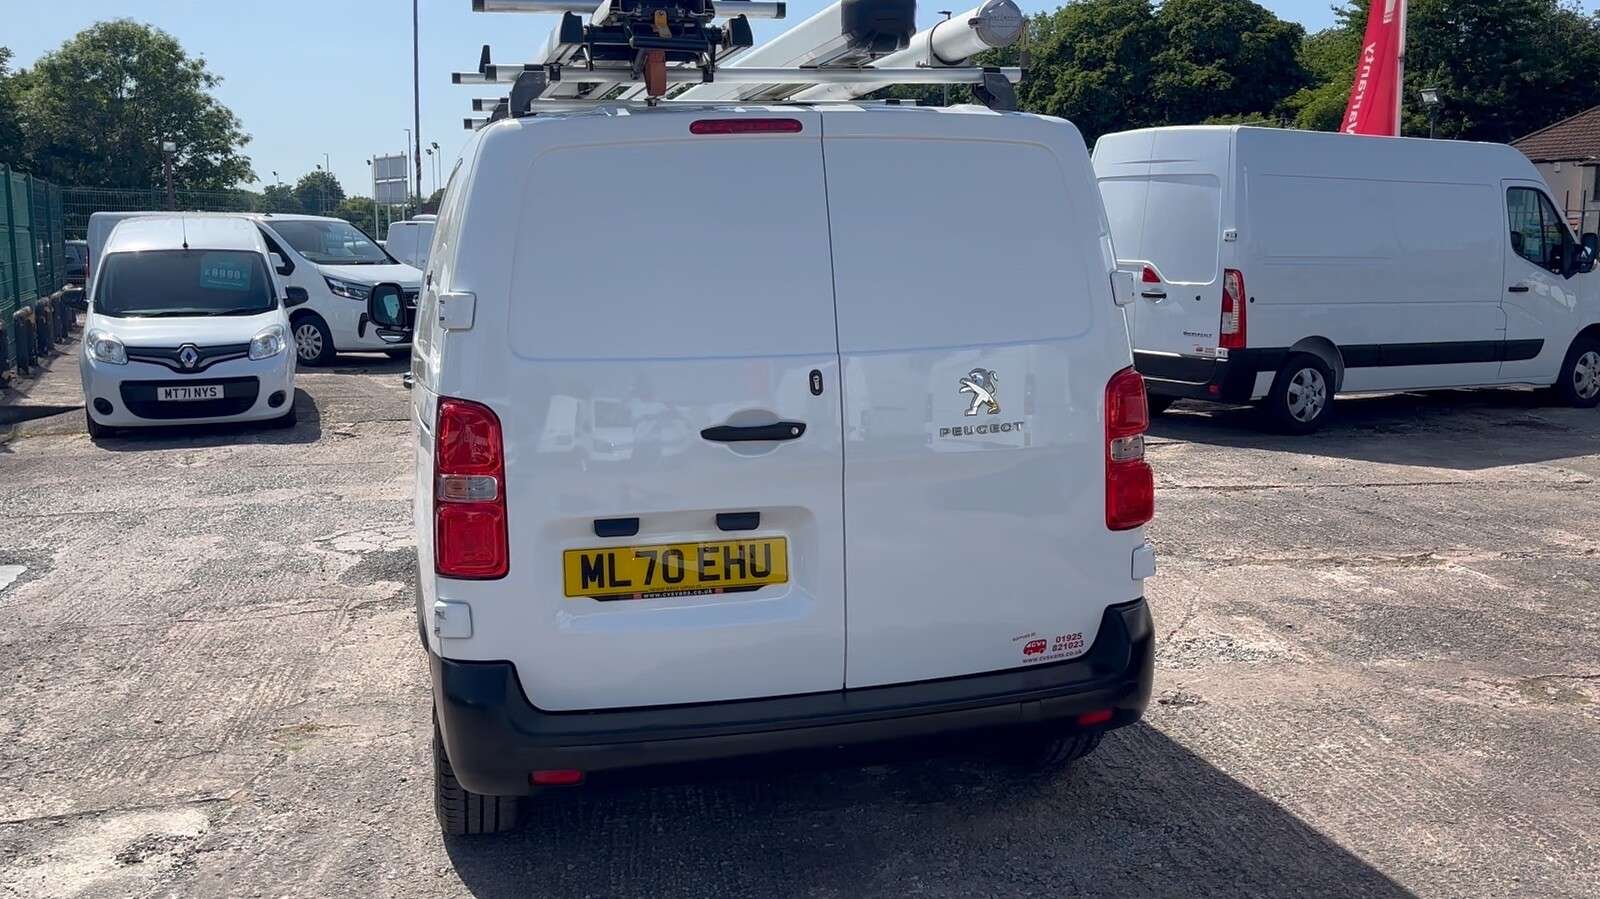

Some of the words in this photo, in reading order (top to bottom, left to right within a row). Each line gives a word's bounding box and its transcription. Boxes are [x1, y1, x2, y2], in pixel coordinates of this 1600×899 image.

[165, 388, 191, 399] MT71
[194, 387, 217, 398] NYS
[939, 422, 1024, 437] PEUGEOT
[698, 543, 772, 581] EHU
[1056, 632, 1083, 643] 01925
[1052, 640, 1084, 651] 821023
